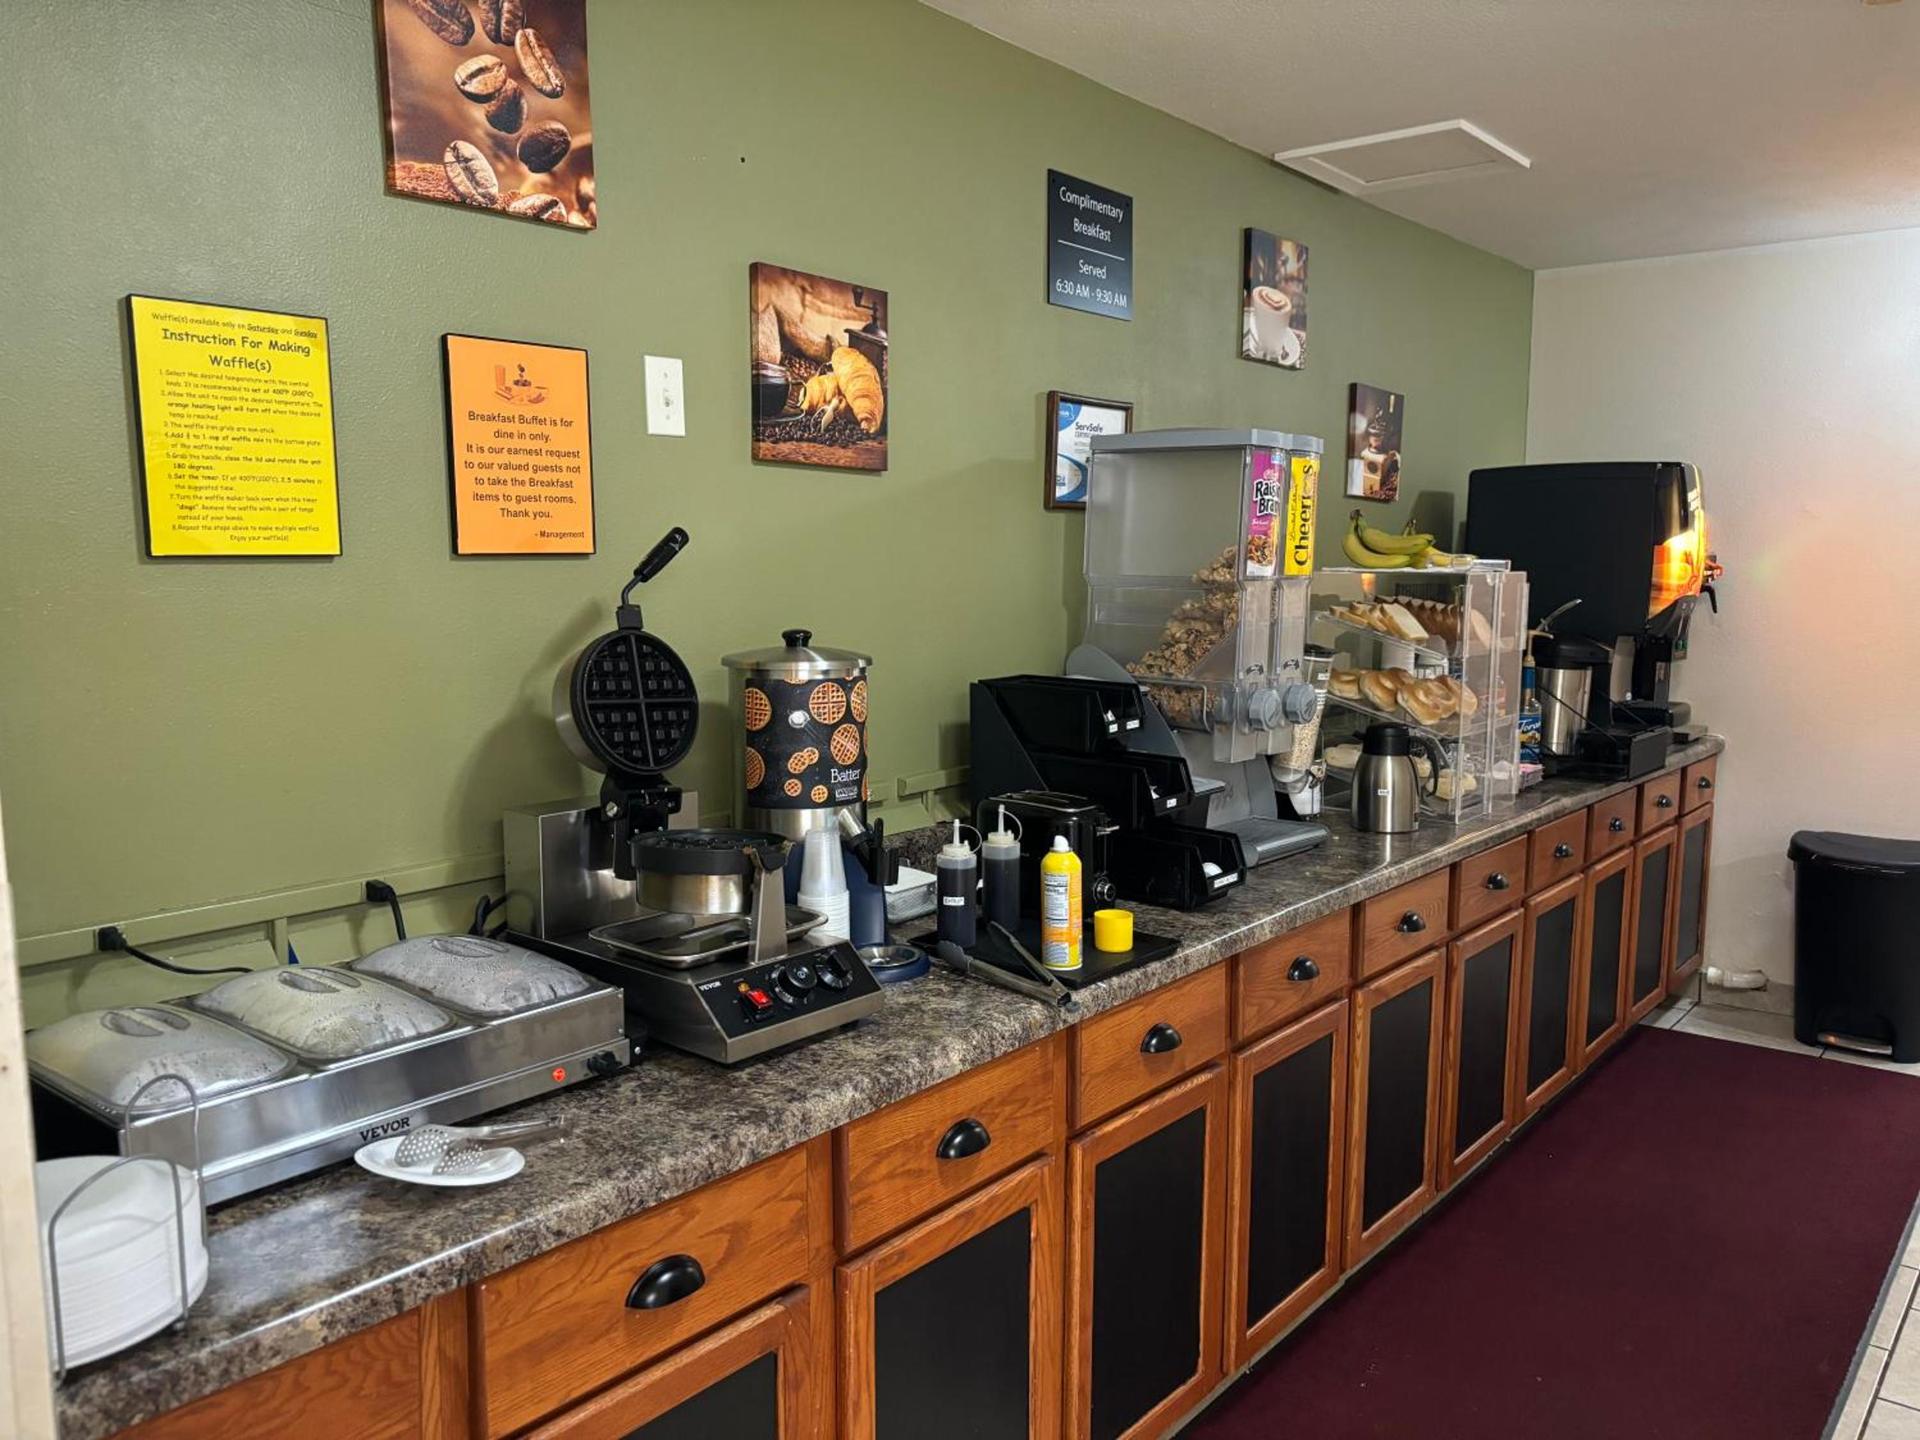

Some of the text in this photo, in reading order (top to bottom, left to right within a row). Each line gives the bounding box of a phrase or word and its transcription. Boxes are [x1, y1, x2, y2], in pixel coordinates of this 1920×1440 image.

[1059, 186, 1123, 223] Complimentary
[1073, 217, 1111, 242] Breakfast
[1079, 259, 1106, 279] Served
[1056, 278, 1074, 295] 6:30
[1075, 283, 1090, 298] AM
[1096, 288, 1112, 304] 9:30
[1114, 293, 1127, 308] AM
[151, 312, 188, 324] Waffle(s)
[189, 318, 220, 327] available
[221, 321, 236, 329] only
[247, 323, 280, 335] Saturday
[161, 328, 311, 358] Instruction For Making
[208, 354, 272, 373] Waffle(s)
[468, 410, 574, 427] Breakfast Buffet is for
[1074, 421, 1104, 433] ServSafe
[493, 429, 551, 444] dine in only.
[466, 442, 580, 459] It is our earnest request
[464, 460, 581, 474] to our valued guests not
[474, 476, 574, 489] to take the Breakfast
[472, 491, 577, 505] items to guest rooms.
[499, 507, 553, 520] Thank you.
[539, 530, 585, 540] Management
[830, 768, 860, 783] Batter
[360, 1116, 410, 1142] VEVOR
